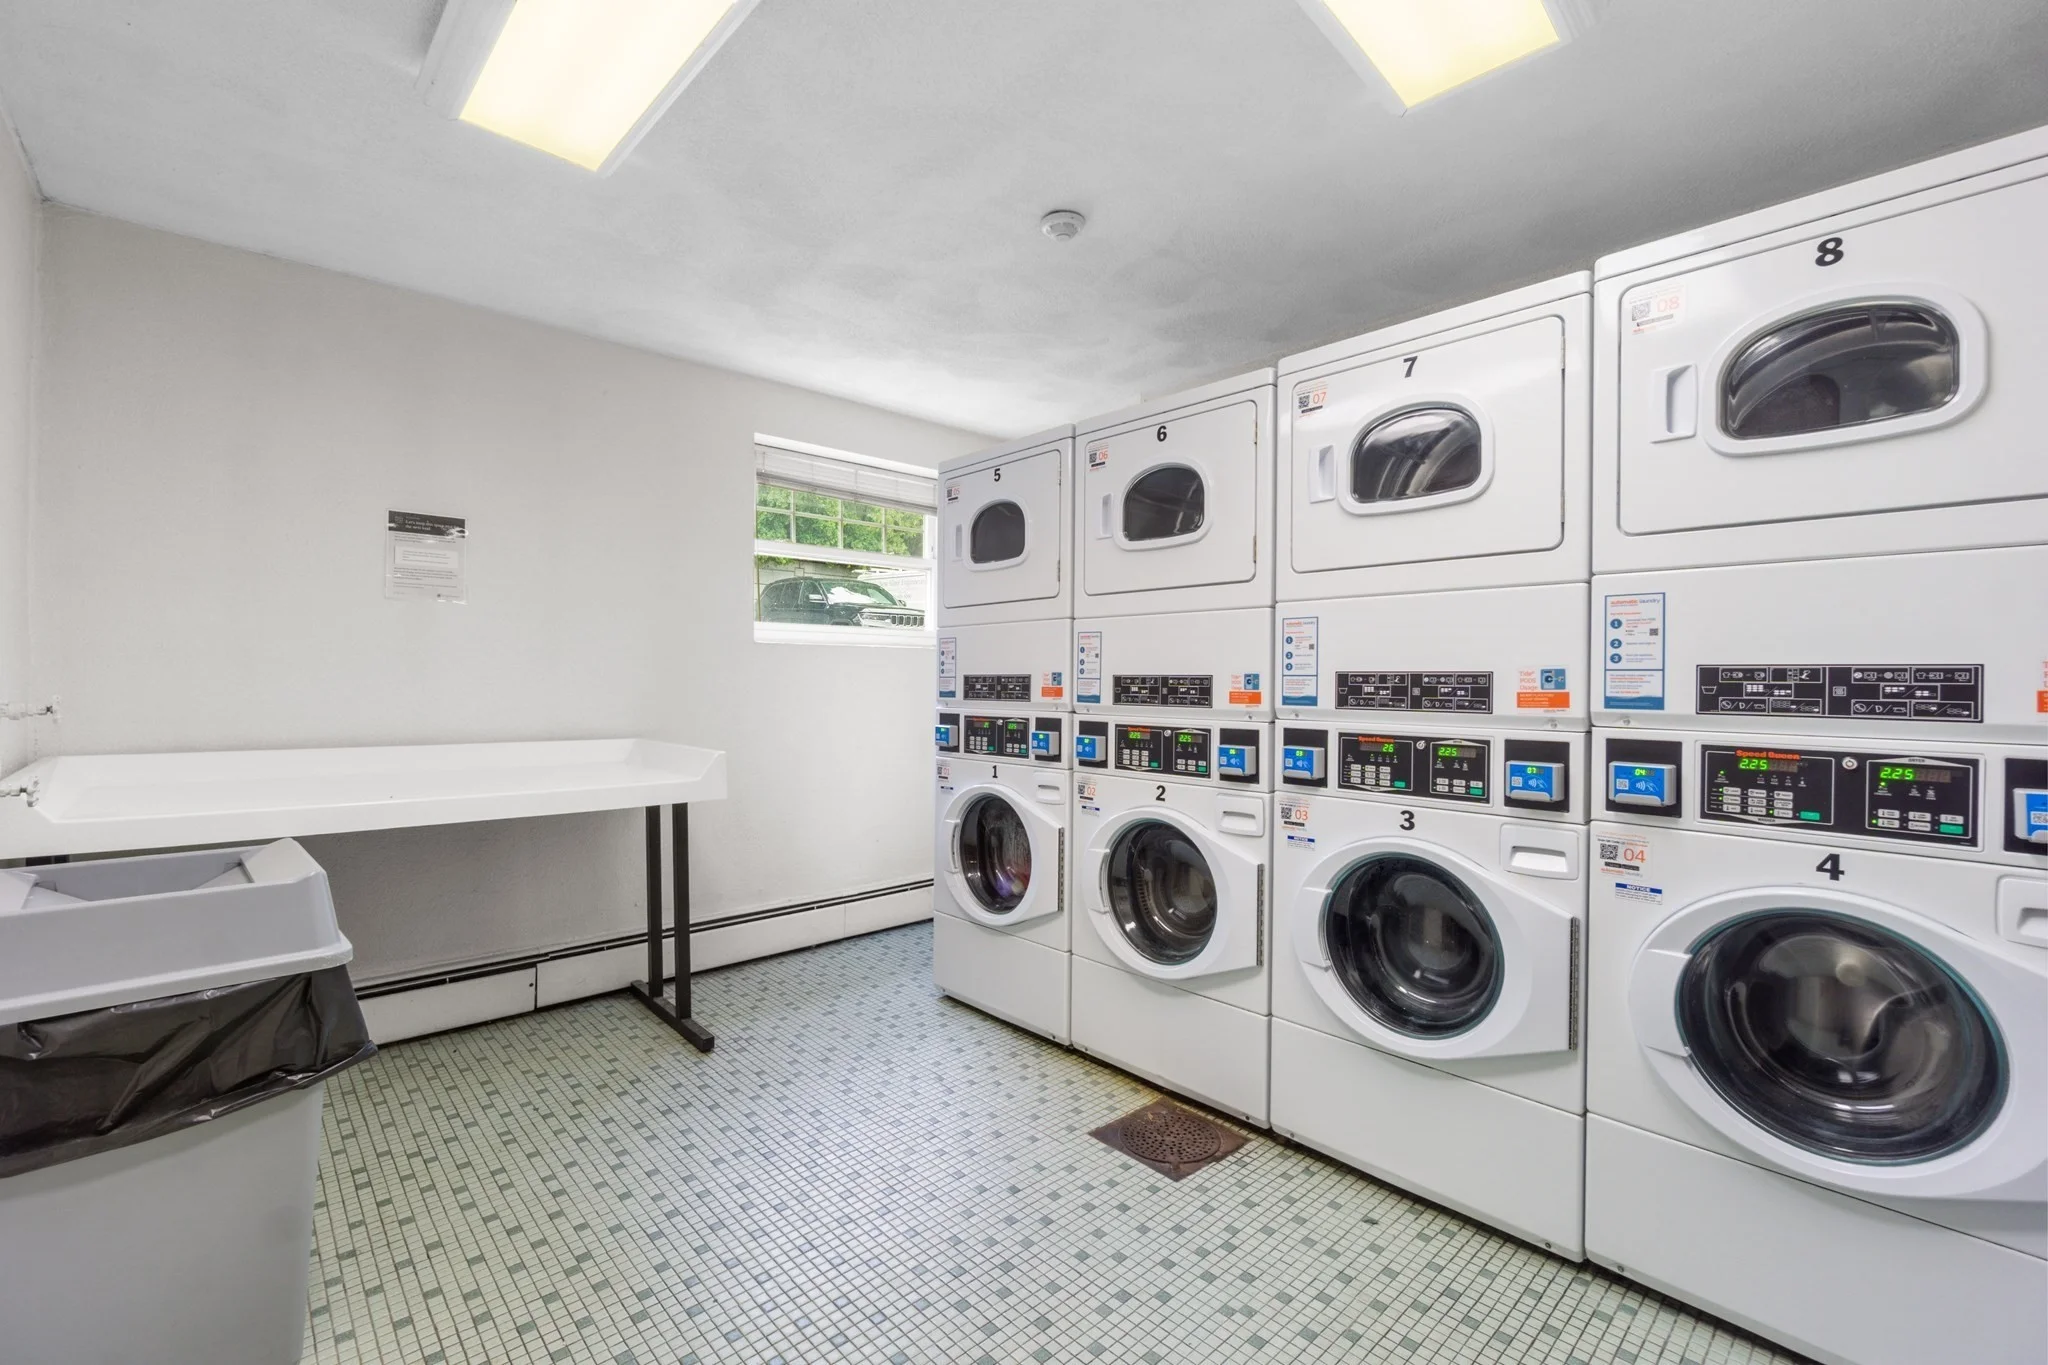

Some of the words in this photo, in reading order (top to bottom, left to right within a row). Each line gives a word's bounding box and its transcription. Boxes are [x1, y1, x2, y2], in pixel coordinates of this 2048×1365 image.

[1815, 237, 1844, 267] 8
[1657, 296, 1680, 312] 08
[1403, 356, 1418, 378] 7
[1312, 391, 1327, 405] 07
[1156, 425, 1168, 442] 6
[1098, 450, 1109, 461] 06
[994, 468, 1001, 482] 5
[1382, 744, 1394, 752] 26
[1735, 749, 1767, 758] Speed
[1768, 751, 1800, 760] Queen
[1739, 758, 1768, 769] 2.25
[992, 765, 999, 778] 1
[1635, 768, 1646, 776] 04
[1880, 767, 1914, 780] 2.25
[1087, 786, 1096, 796] 02
[1155, 785, 1166, 802] 2
[1295, 809, 1308, 821] 03
[1399, 810, 1416, 831] 3
[1623, 848, 1646, 864] 04
[1815, 853, 1845, 881] 4
